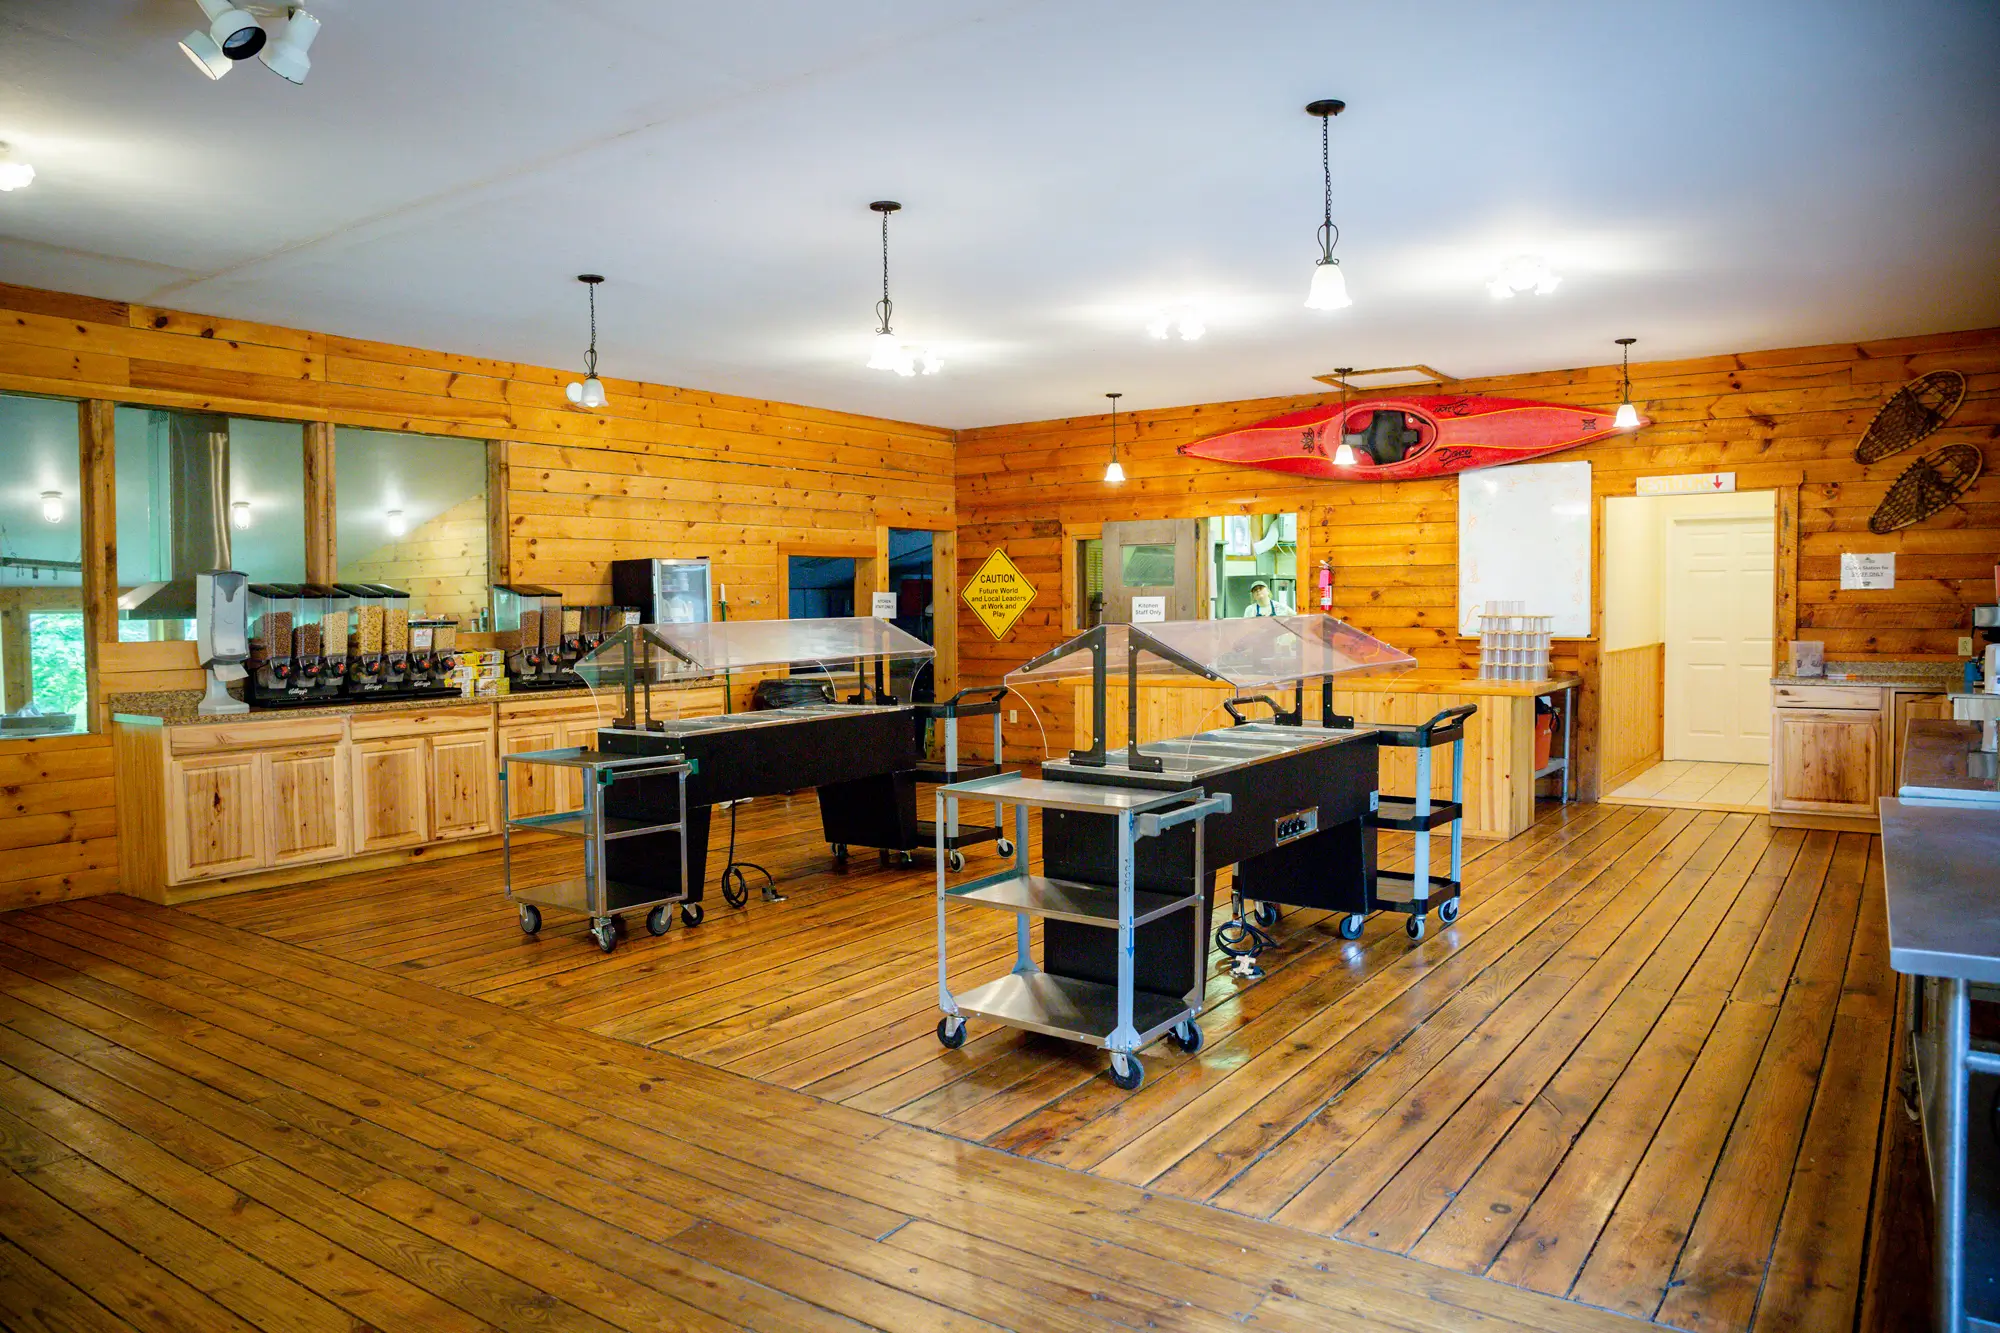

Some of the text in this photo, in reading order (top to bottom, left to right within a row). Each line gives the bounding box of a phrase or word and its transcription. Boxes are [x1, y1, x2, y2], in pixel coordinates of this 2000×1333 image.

[1638, 475, 1712, 493] RESTROOMS
[980, 574, 1015, 583] CAUTION
[992, 611, 1005, 619] Play
[288, 687, 309, 695] Kellogg's
